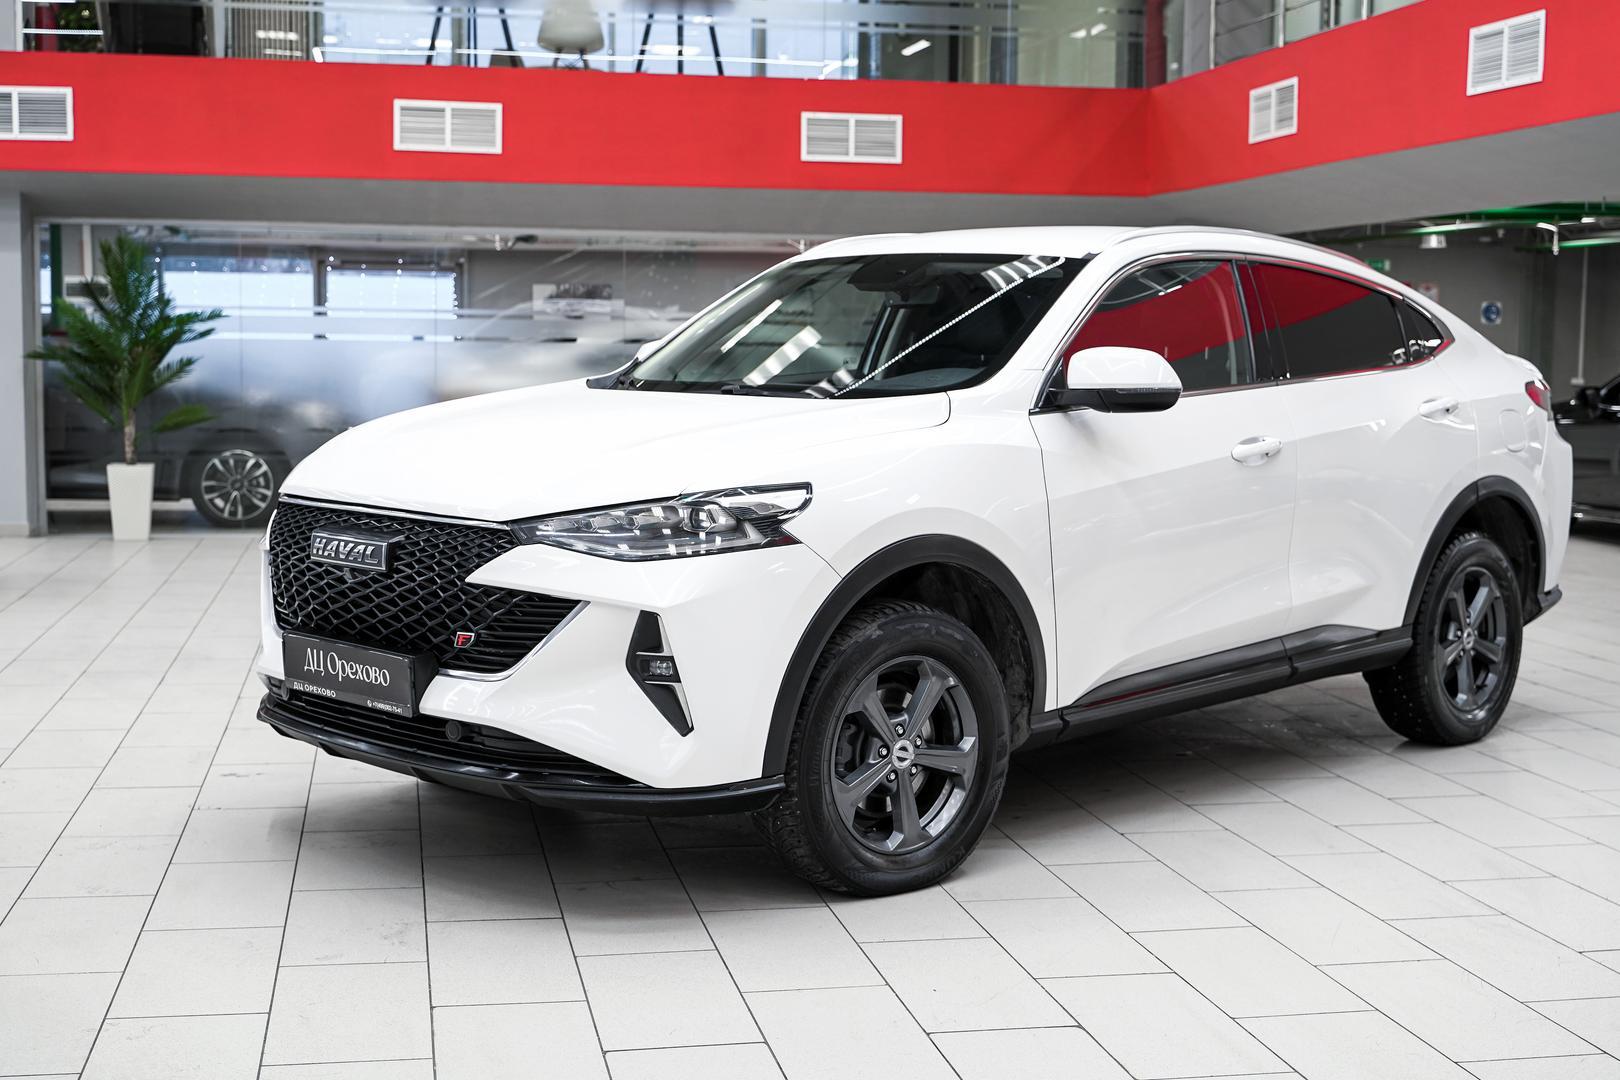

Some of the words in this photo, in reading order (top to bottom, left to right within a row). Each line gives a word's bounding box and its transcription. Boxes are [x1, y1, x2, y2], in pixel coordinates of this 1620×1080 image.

[312, 537, 379, 564] HAVAL
[303, 647, 325, 677] ДЦ
[327, 651, 390, 687] Орехово
[293, 681, 304, 691] ДЦ
[304, 684, 336, 698] ОРЕХОВО
